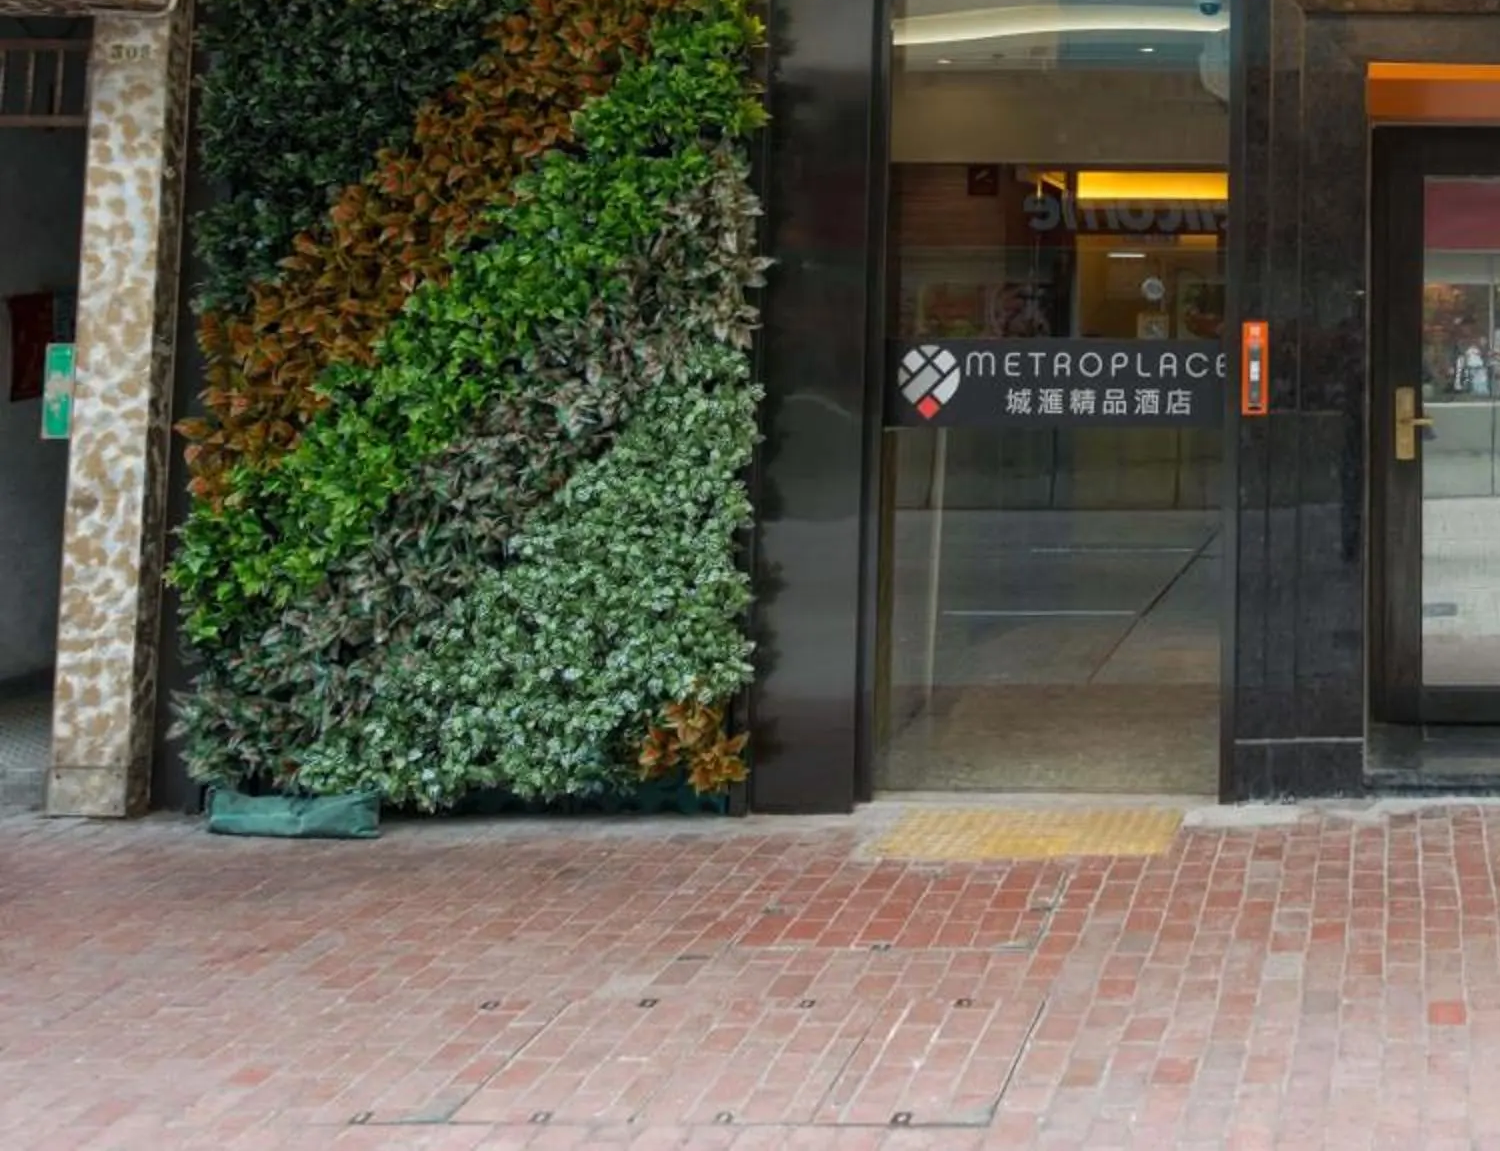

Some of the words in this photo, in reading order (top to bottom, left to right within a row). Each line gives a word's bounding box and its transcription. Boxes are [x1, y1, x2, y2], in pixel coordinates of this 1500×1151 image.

[1005, 388, 1192, 416] 城滙精品酒店
